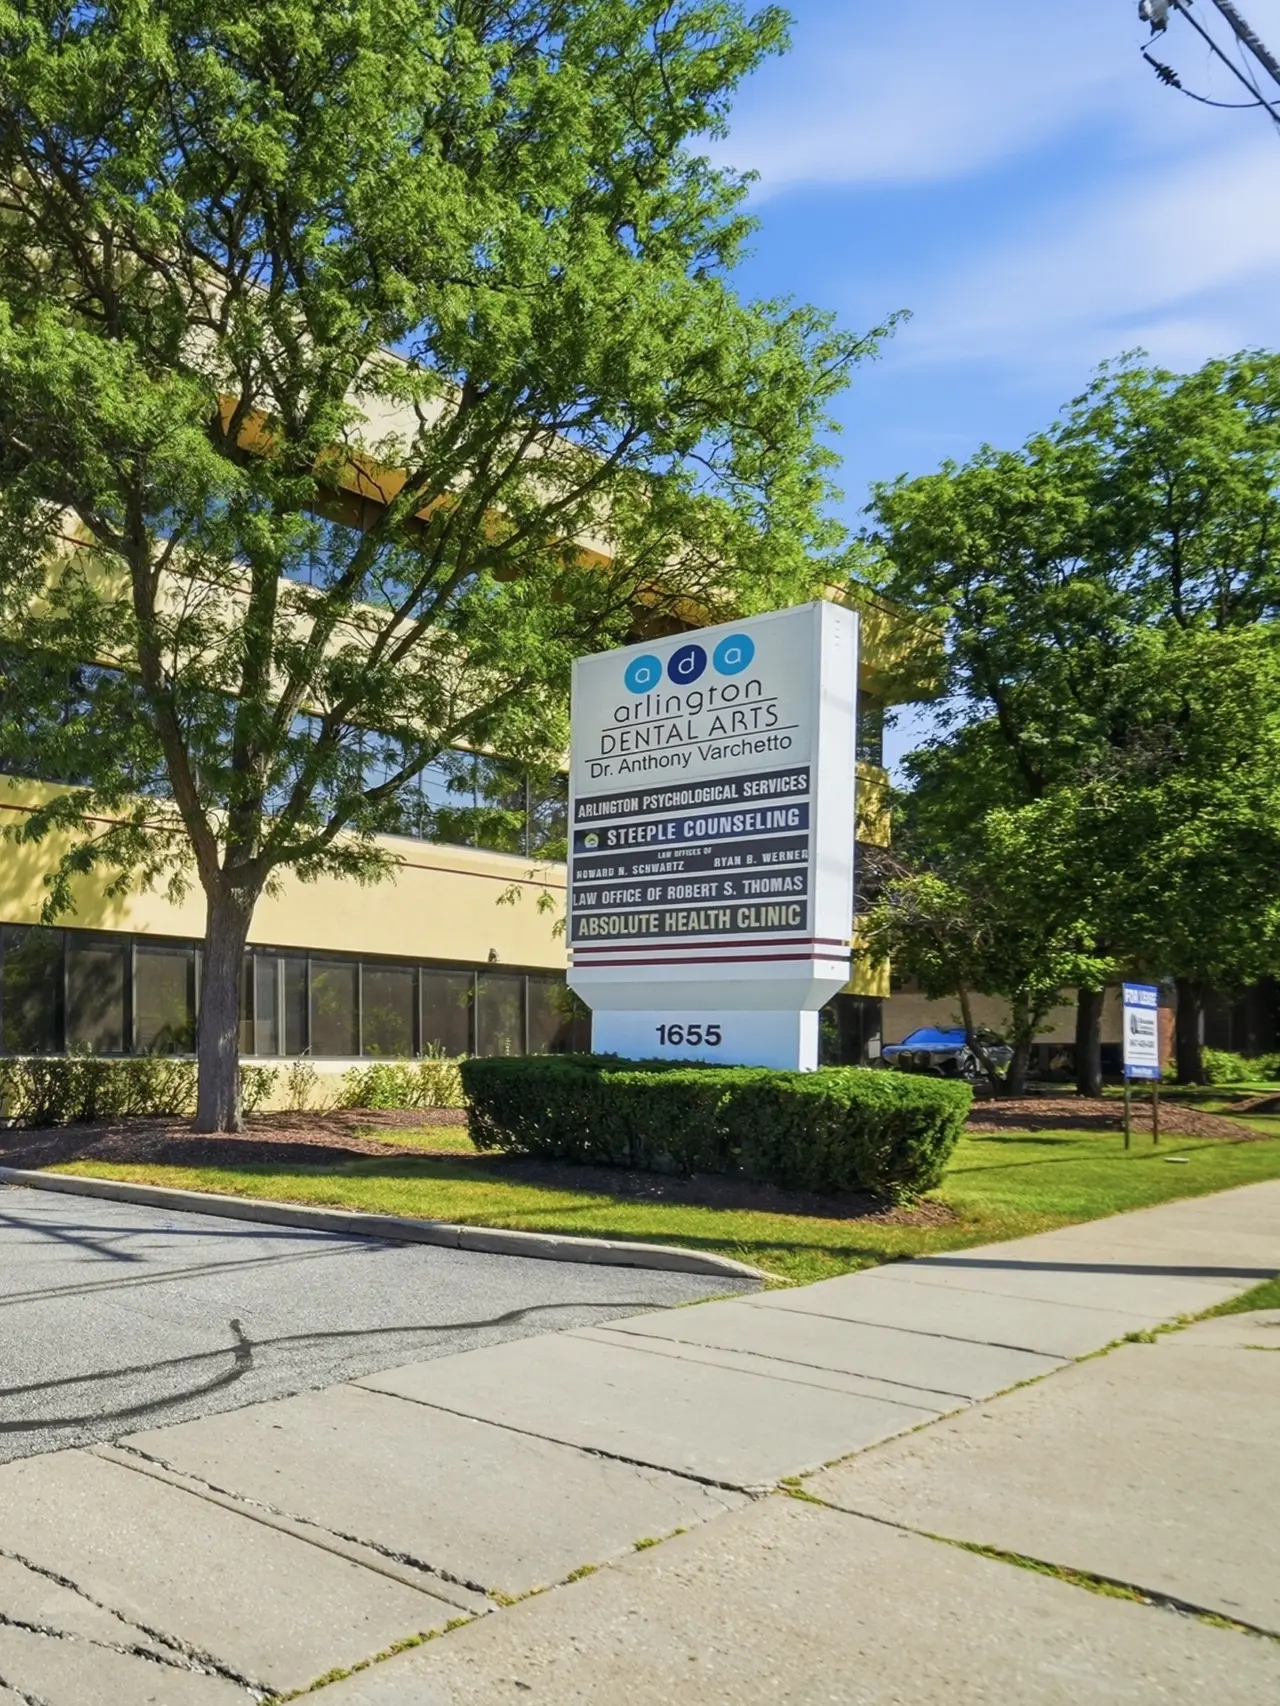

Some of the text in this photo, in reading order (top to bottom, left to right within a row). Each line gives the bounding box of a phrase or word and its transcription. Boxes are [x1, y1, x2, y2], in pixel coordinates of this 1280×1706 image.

[613, 679, 763, 723] arlington
[600, 704, 779, 755] DENTAL ARTS
[590, 733, 793, 779] Dr. Anthony Varchetto
[577, 774, 808, 819] ARLINGTON PSYCHOLOGICAL SERVICES
[606, 808, 800, 846] STEEPLE COUNSELING
[657, 851, 672, 860] LAW
[703, 847, 712, 855] OF
[713, 849, 809, 868] RYAN B. WERNER
[576, 861, 685, 880] HOWARD N. SCHWARTZ
[573, 875, 804, 907] LAW OFFICE OF ROBERT S. THOMAS
[578, 904, 801, 937] ABSOLUTE HEALTH CLINIC
[655, 1024, 722, 1046] 1655
